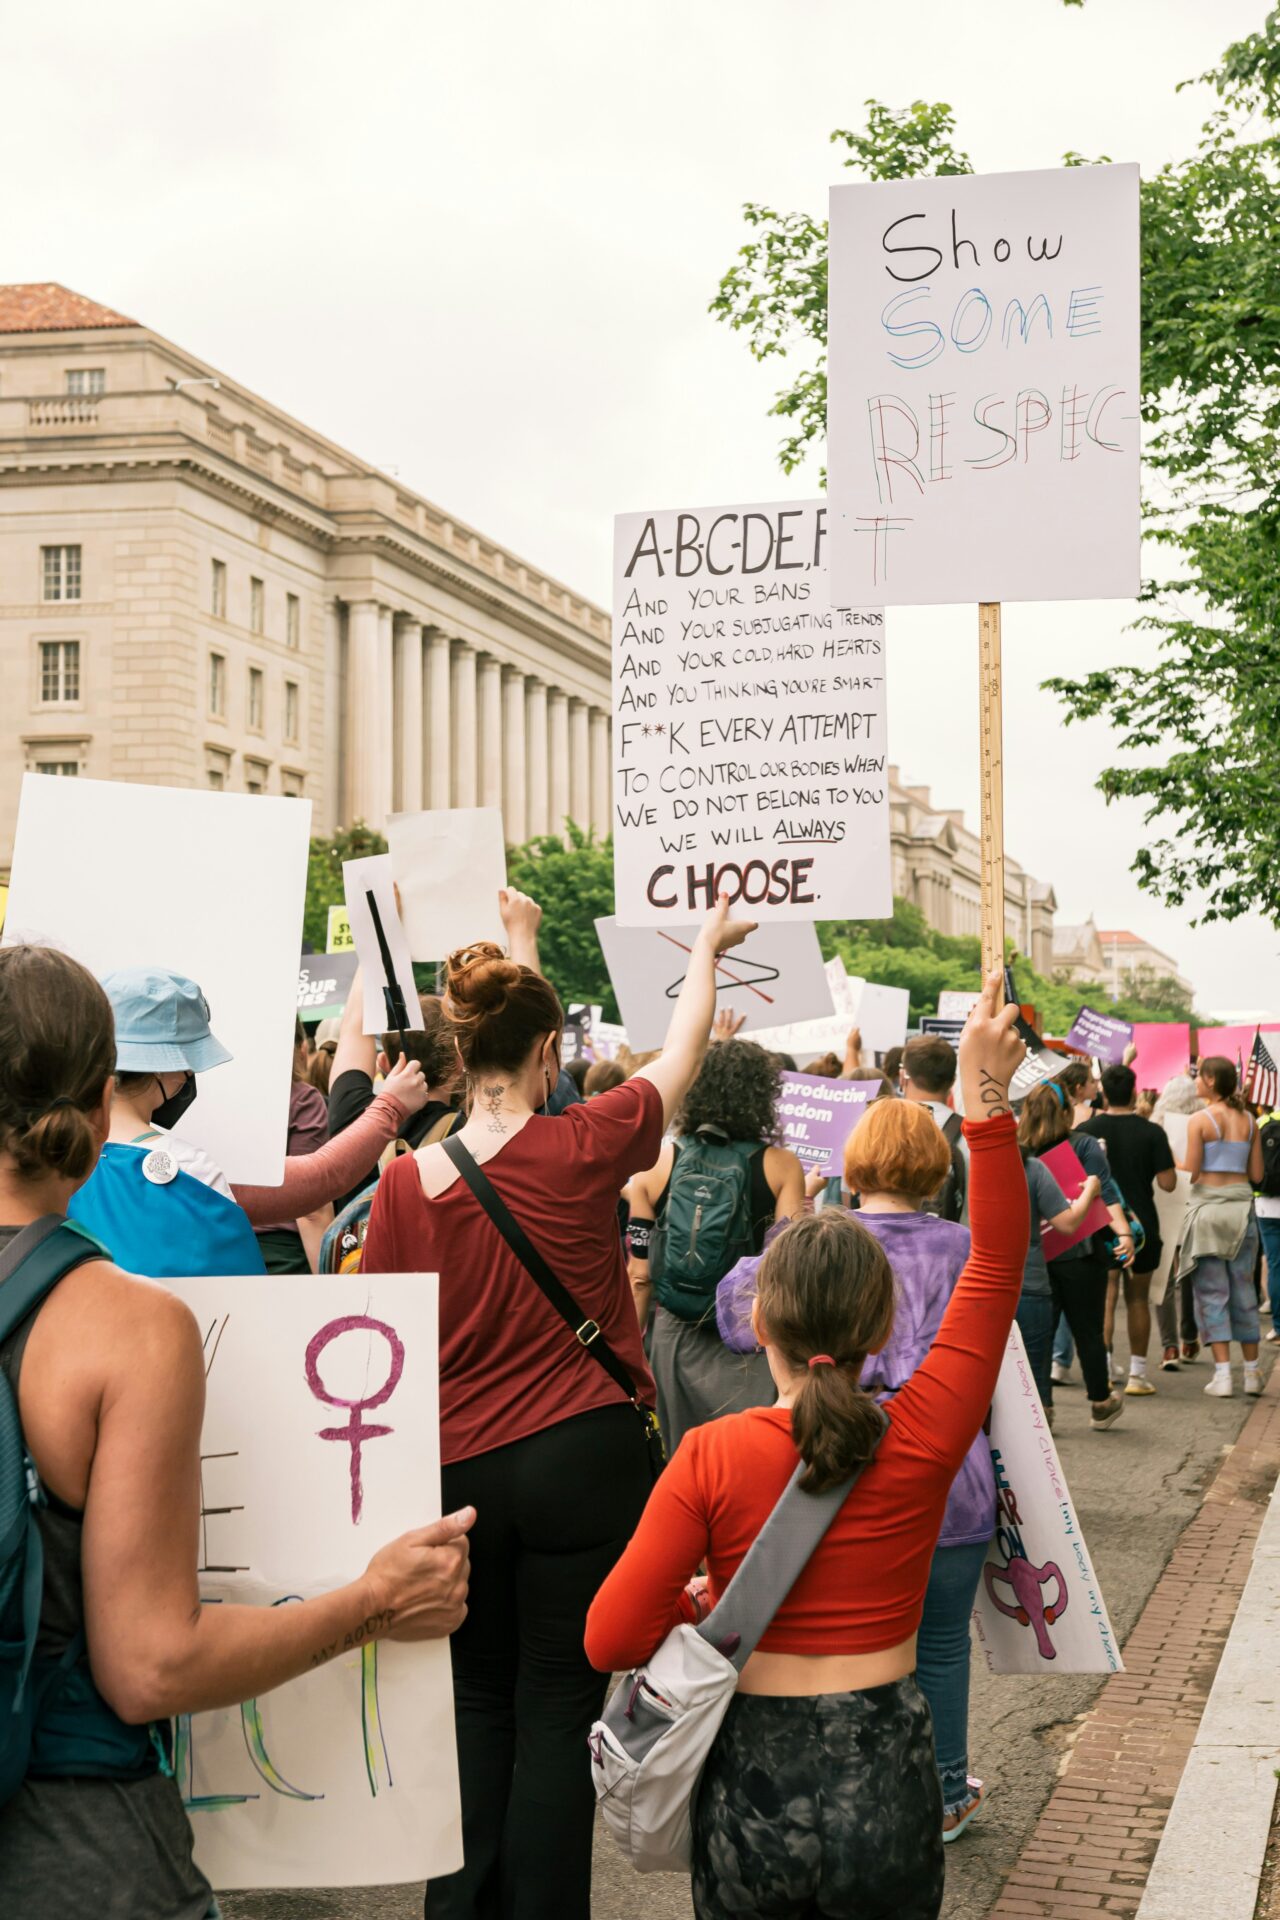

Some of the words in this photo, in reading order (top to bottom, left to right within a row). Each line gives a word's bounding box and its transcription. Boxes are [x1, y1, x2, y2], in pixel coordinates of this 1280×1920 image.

[882, 208, 1062, 282] Show
[881, 286, 1105, 370] SOME
[622, 588, 669, 618] AND
[688, 588, 744, 610] YOUR
[754, 582, 811, 604] BANS
[620, 621, 665, 647] AND
[680, 620, 725, 640] YOUR
[732, 613, 832, 637] SUBJUGATING
[836, 608, 883, 626] TRENDS
[620, 654, 662, 680] AND
[677, 651, 726, 672] YOUR
[777, 644, 814, 661] HARD
[822, 639, 881, 658] HEARTS
[618, 685, 657, 712] AND
[666, 684, 697, 705] YOU
[700, 680, 778, 698] THINKING
[832, 676, 883, 692] SMART
[700, 718, 774, 747] EVERY
[779, 713, 877, 744] ATTEMPT
[617, 767, 650, 797] TO
[659, 762, 756, 793] CONTROL
[759, 762, 789, 778] OUR
[791, 760, 840, 778] BODIES
[844, 755, 885, 773] WHEN
[617, 803, 657, 827] WE
[673, 799, 699, 820] DO
[706, 793, 749, 815] NOT
[757, 789, 820, 811] BELONG
[826, 788, 848, 805] TO
[852, 787, 884, 805] YOU
[659, 833, 697, 853] WE
[711, 826, 763, 845] WILL
[772, 819, 846, 842] ALWAYS
[646, 857, 822, 910] CHOOSE.
